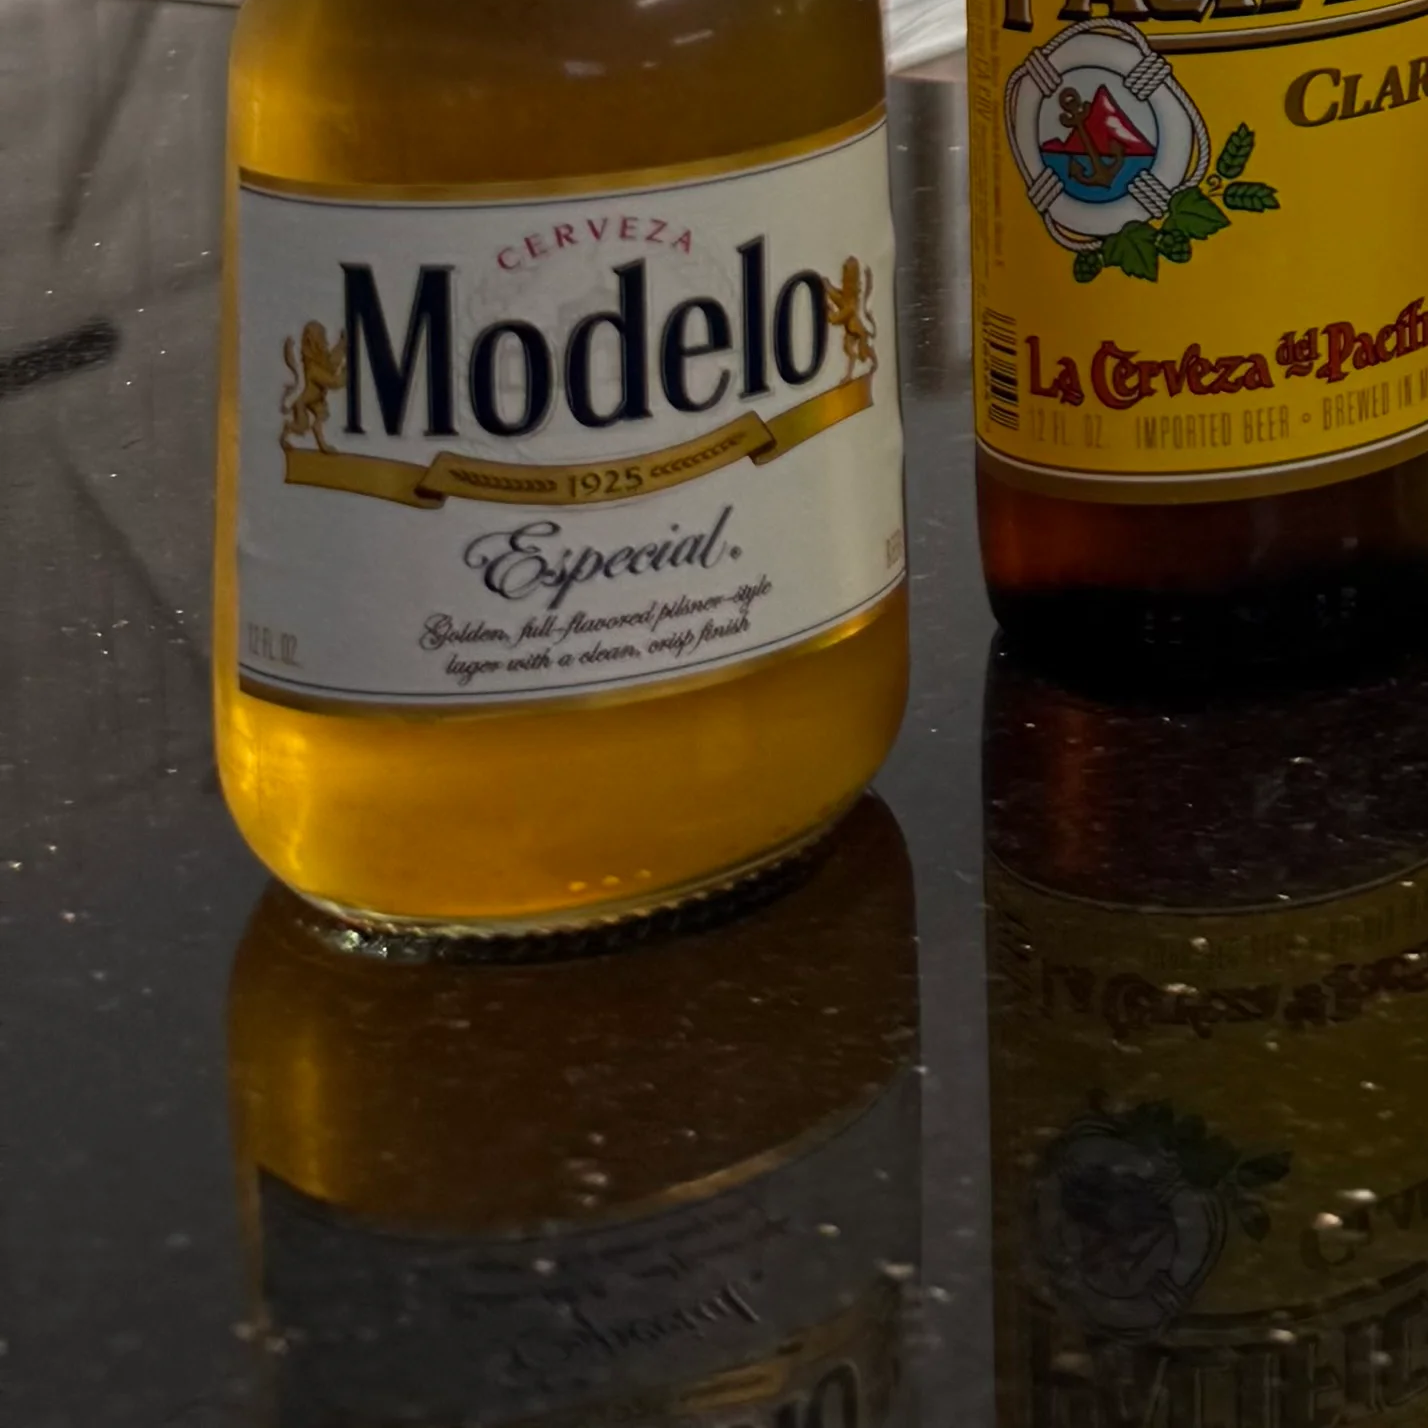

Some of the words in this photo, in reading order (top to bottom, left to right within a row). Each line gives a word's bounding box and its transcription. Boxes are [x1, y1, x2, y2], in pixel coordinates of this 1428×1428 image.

[495, 215, 694, 272] CERVEZA
[338, 234, 830, 439] Modelo
[1024, 335, 1085, 406] La
[1090, 339, 1275, 410] Cerveza
[1275, 326, 1321, 379] del
[1134, 412, 1232, 451] IMPORTED
[1243, 403, 1290, 444] BEER
[1322, 381, 1391, 432] BREWED
[1397, 374, 1413, 409] IN
[566, 467, 645, 499] 1925
[506, 647, 553, 675] with
[557, 654, 574, 669] a
